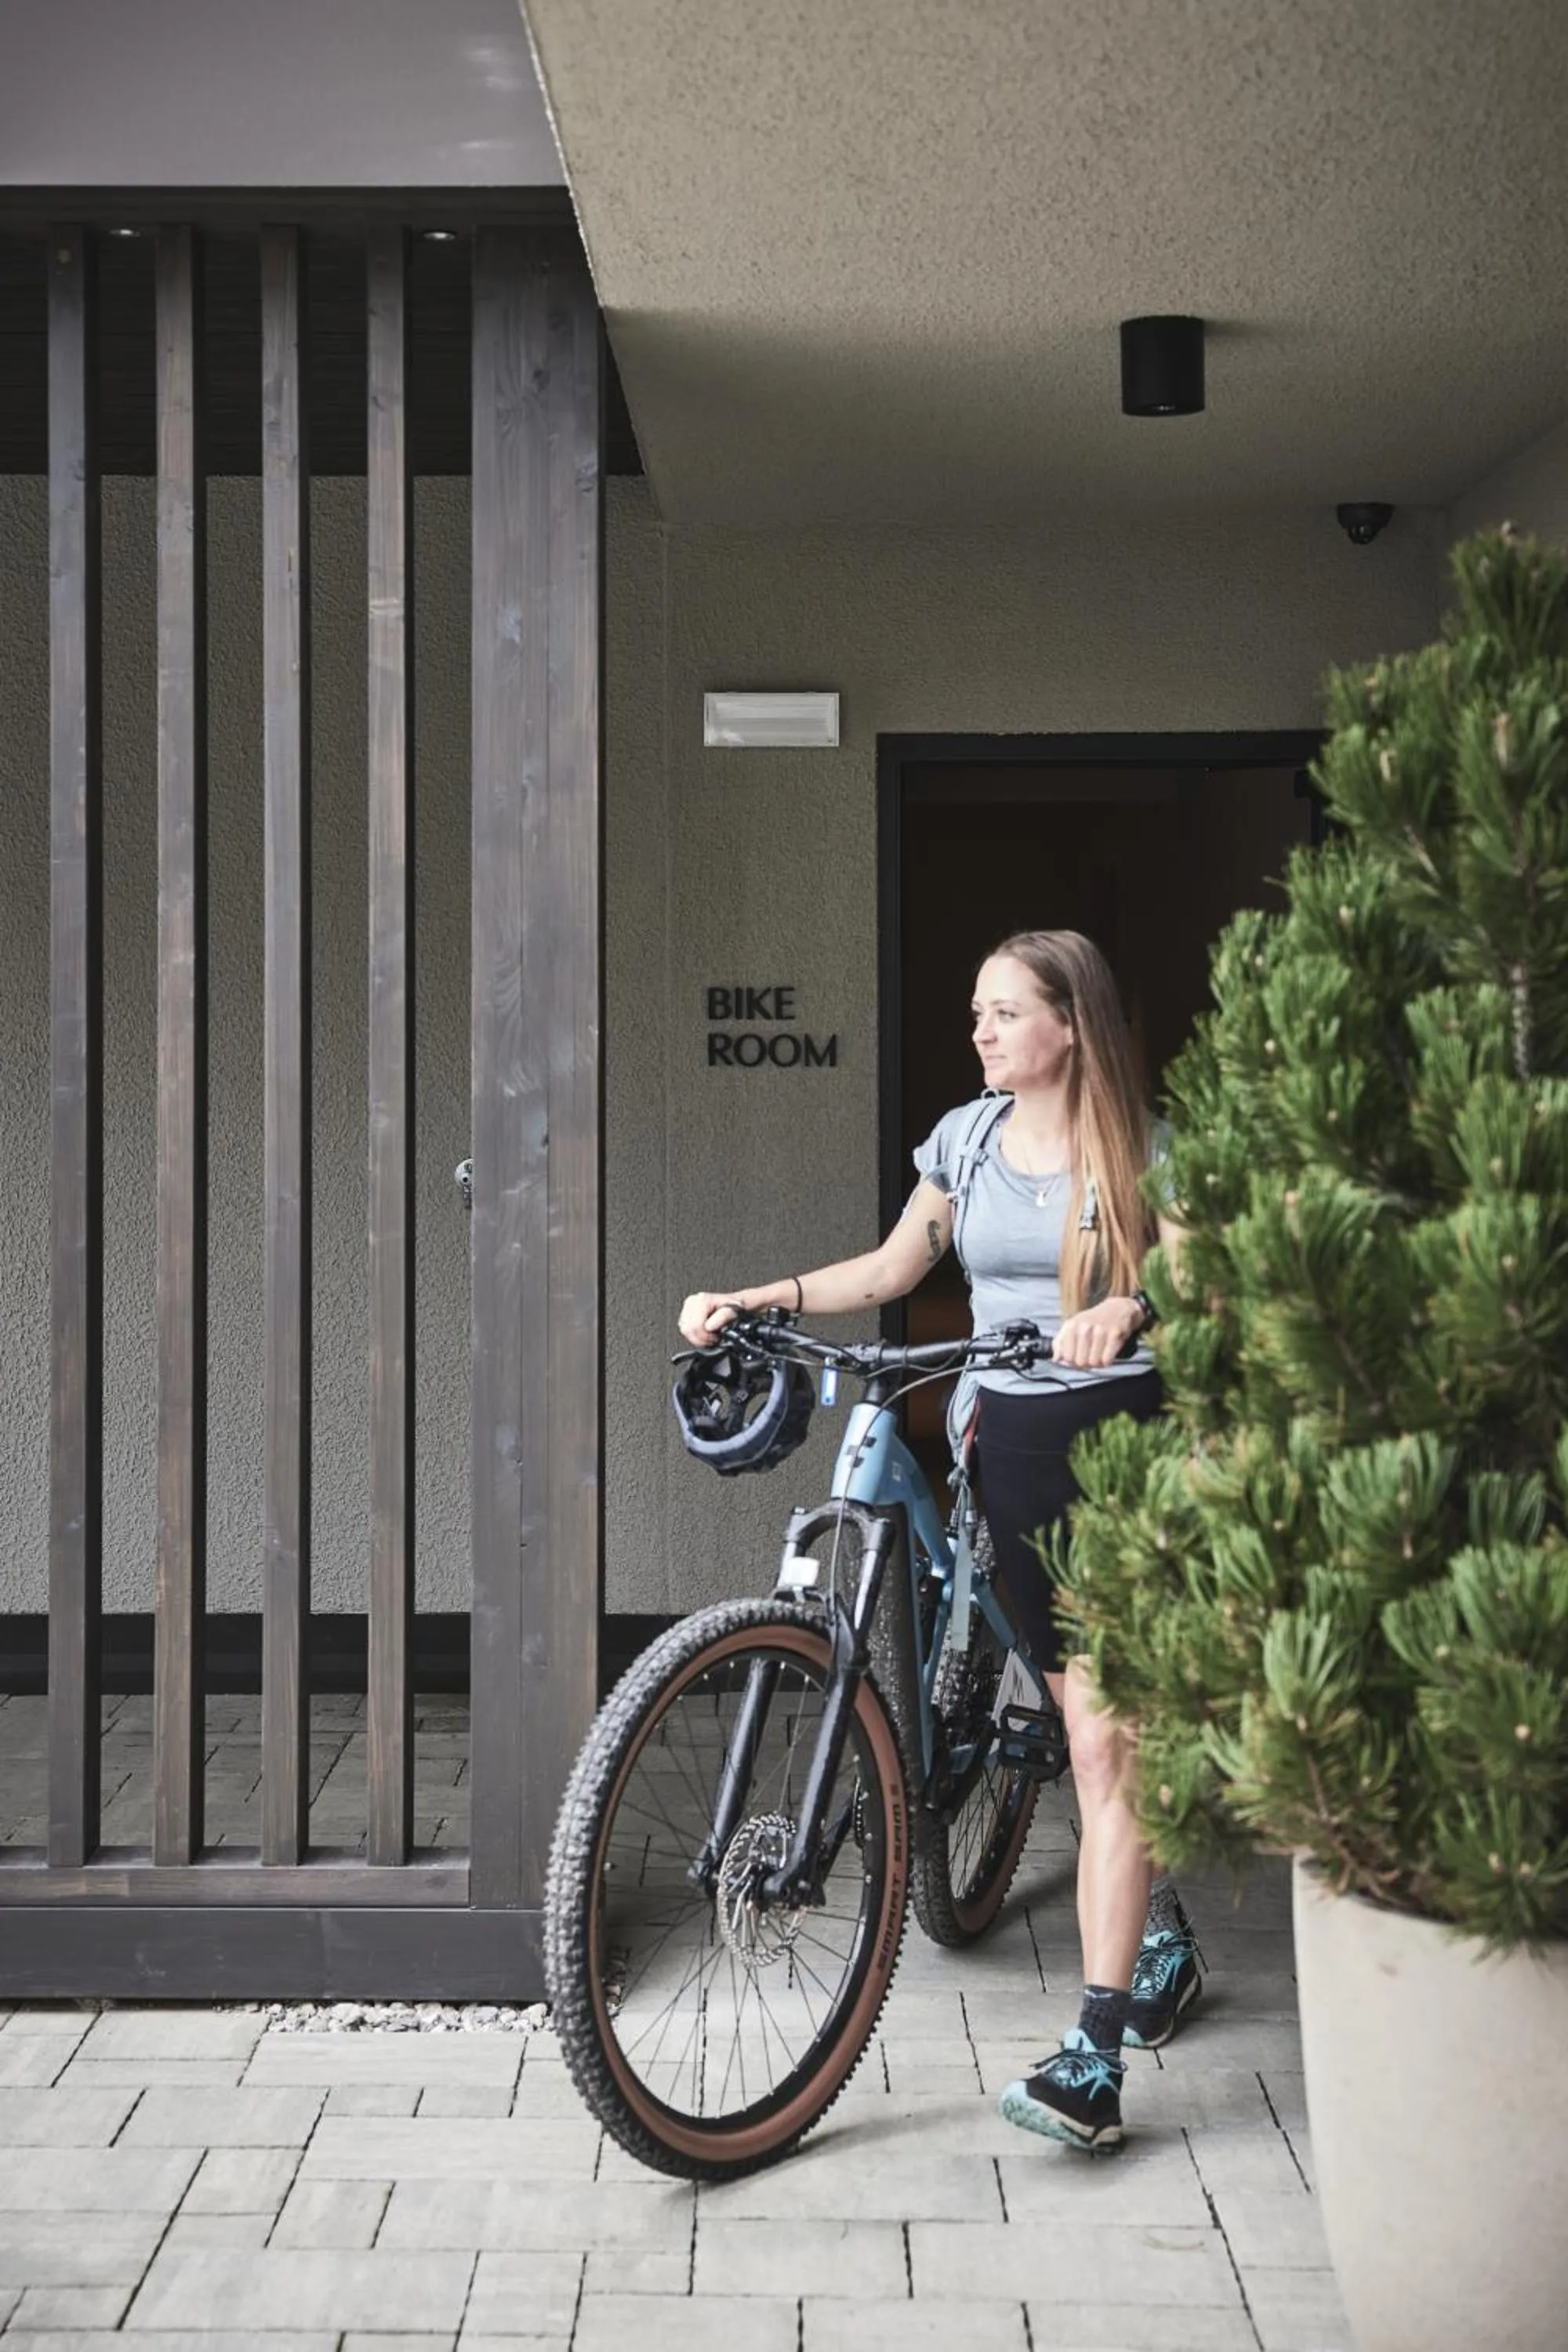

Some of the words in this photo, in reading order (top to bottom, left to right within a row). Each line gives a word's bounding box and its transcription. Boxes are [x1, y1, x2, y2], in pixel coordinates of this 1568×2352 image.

[708, 986, 796, 1020] BIKE
[708, 1033, 837, 1067] ROOM
[877, 1872, 901, 1969] SMART
